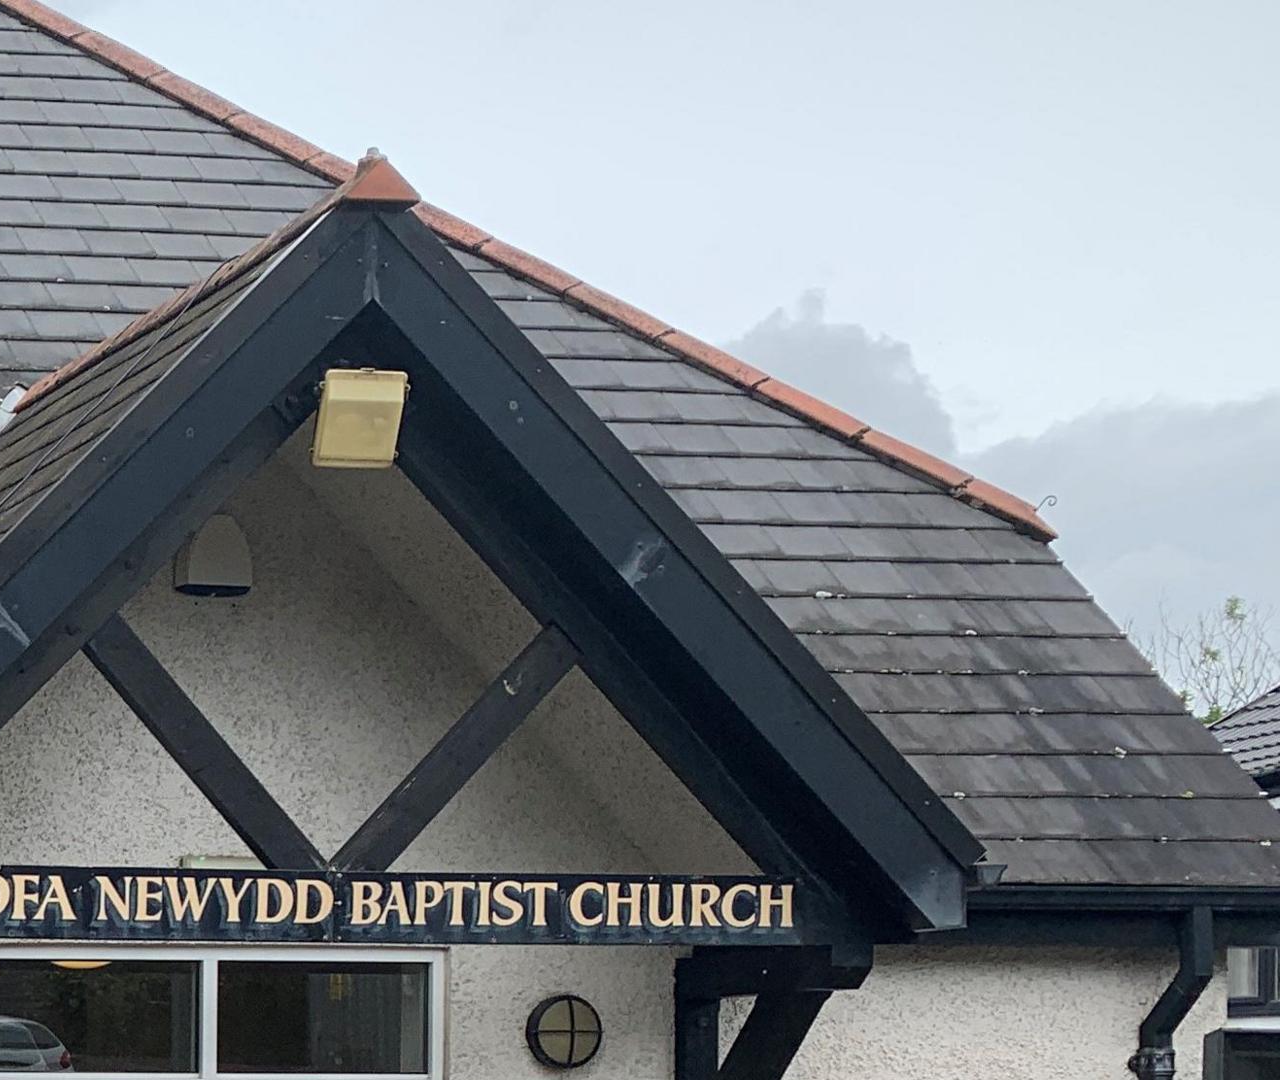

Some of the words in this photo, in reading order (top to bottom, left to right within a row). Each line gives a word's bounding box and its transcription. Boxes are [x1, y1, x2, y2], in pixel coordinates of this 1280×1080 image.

[94, 875, 335, 925] NEWYDD
[350, 879, 558, 927] BAPTIST
[569, 881, 794, 929] CHURCH
